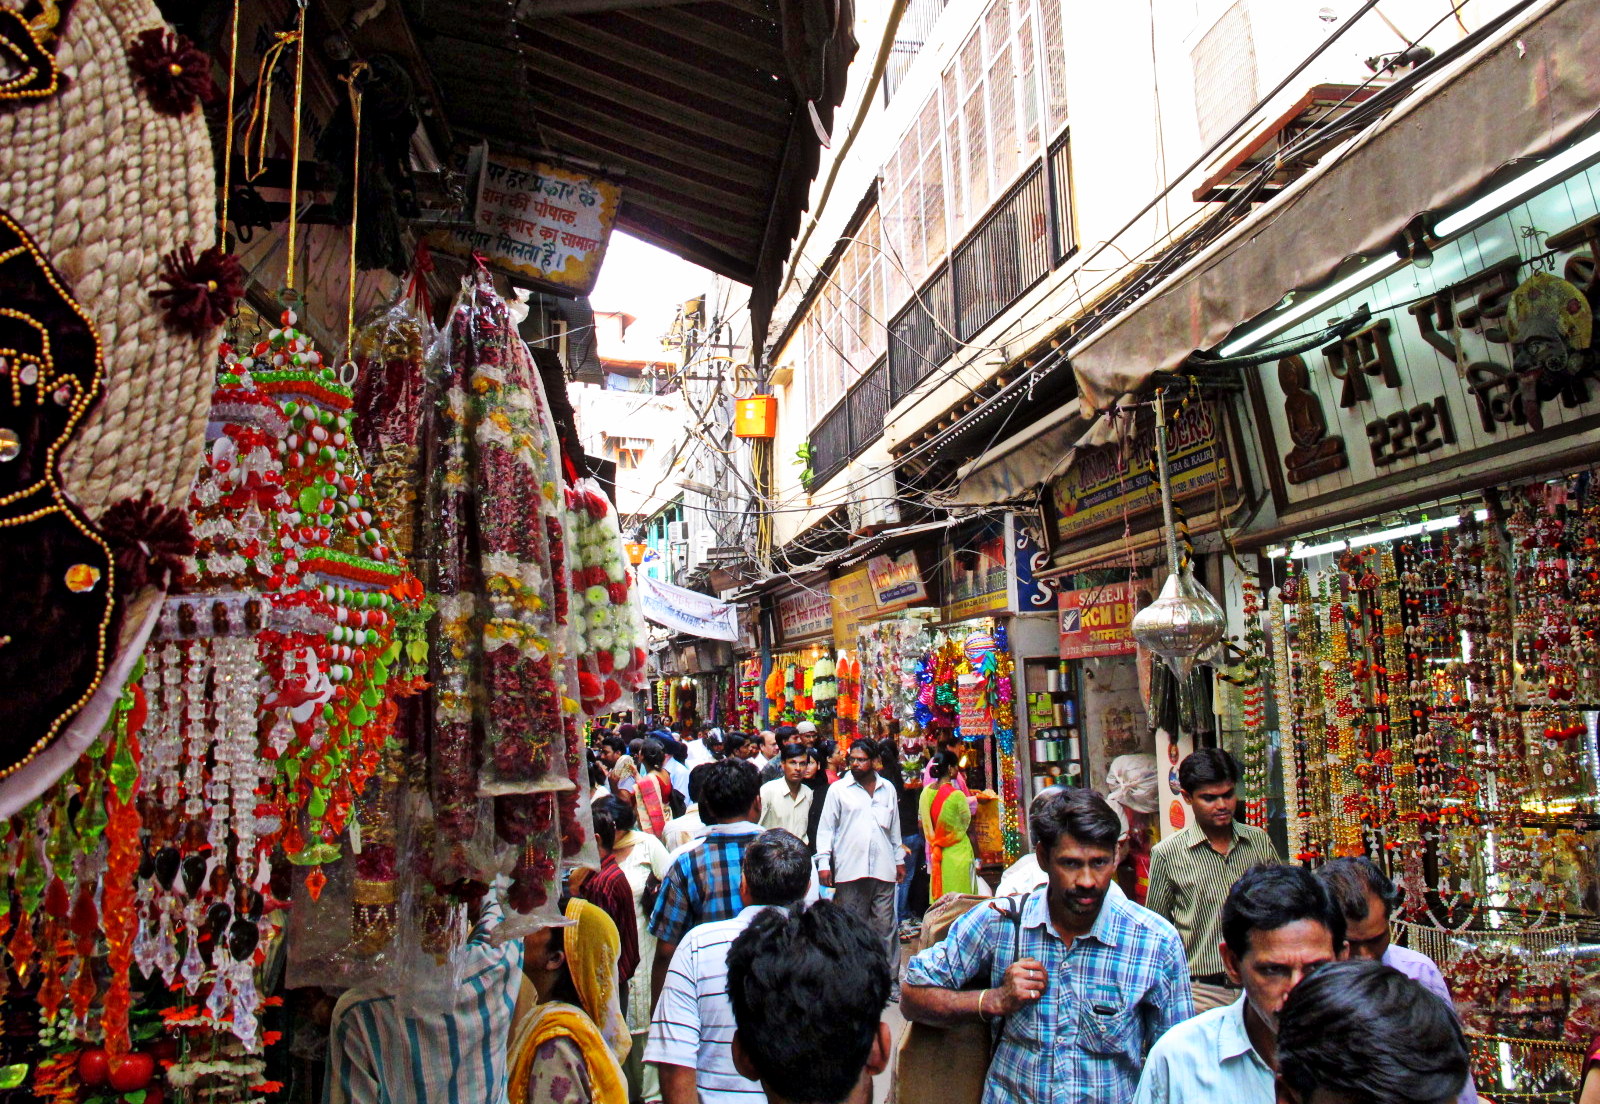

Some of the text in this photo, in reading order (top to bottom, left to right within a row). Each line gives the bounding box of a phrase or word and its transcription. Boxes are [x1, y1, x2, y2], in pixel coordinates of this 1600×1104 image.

[531, 175, 575, 201] प्रकार
[538, 227, 561, 246] का
[561, 231, 600, 252] सामान
[1366, 395, 1456, 467] 2221
